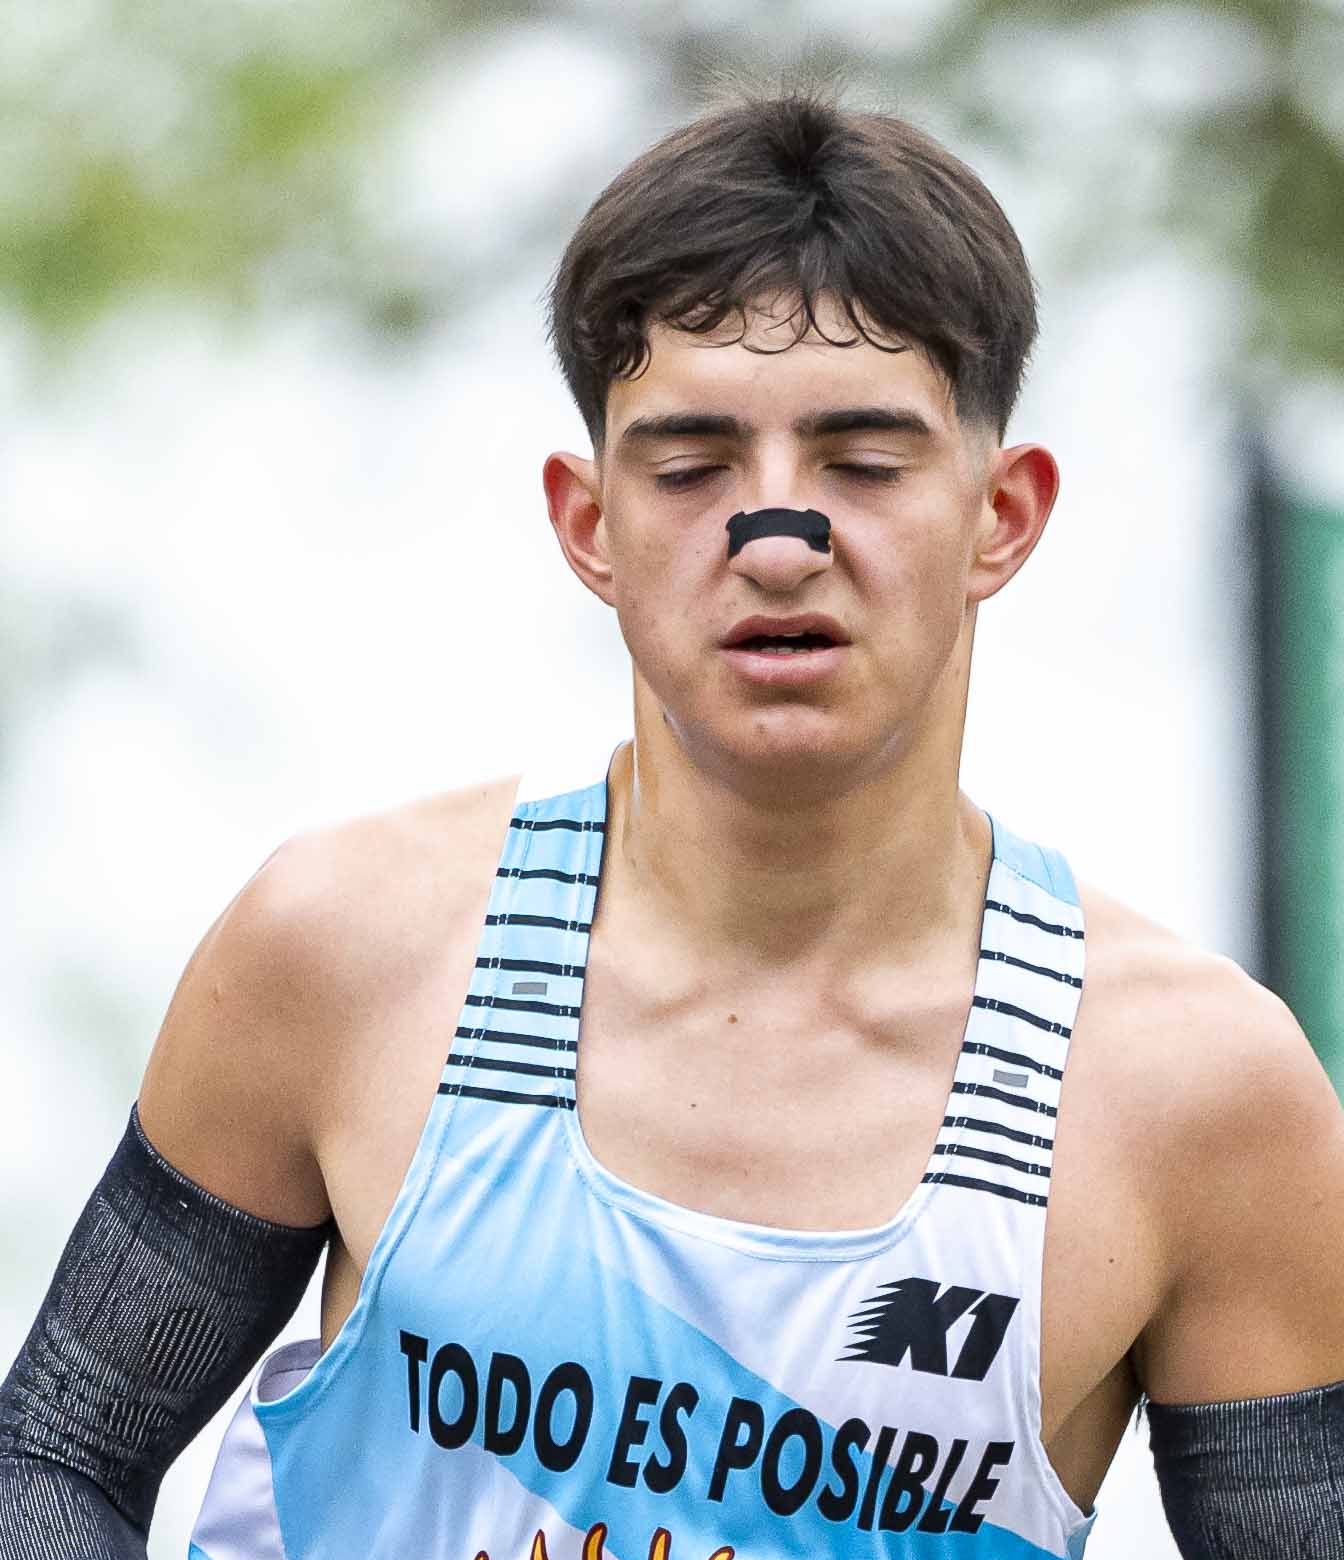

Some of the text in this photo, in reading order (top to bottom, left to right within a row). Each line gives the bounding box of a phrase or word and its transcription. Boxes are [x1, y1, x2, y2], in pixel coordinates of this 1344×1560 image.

[834, 1276, 1021, 1382] K1
[398, 1328, 1016, 1535] TODO ES POSIBLE
